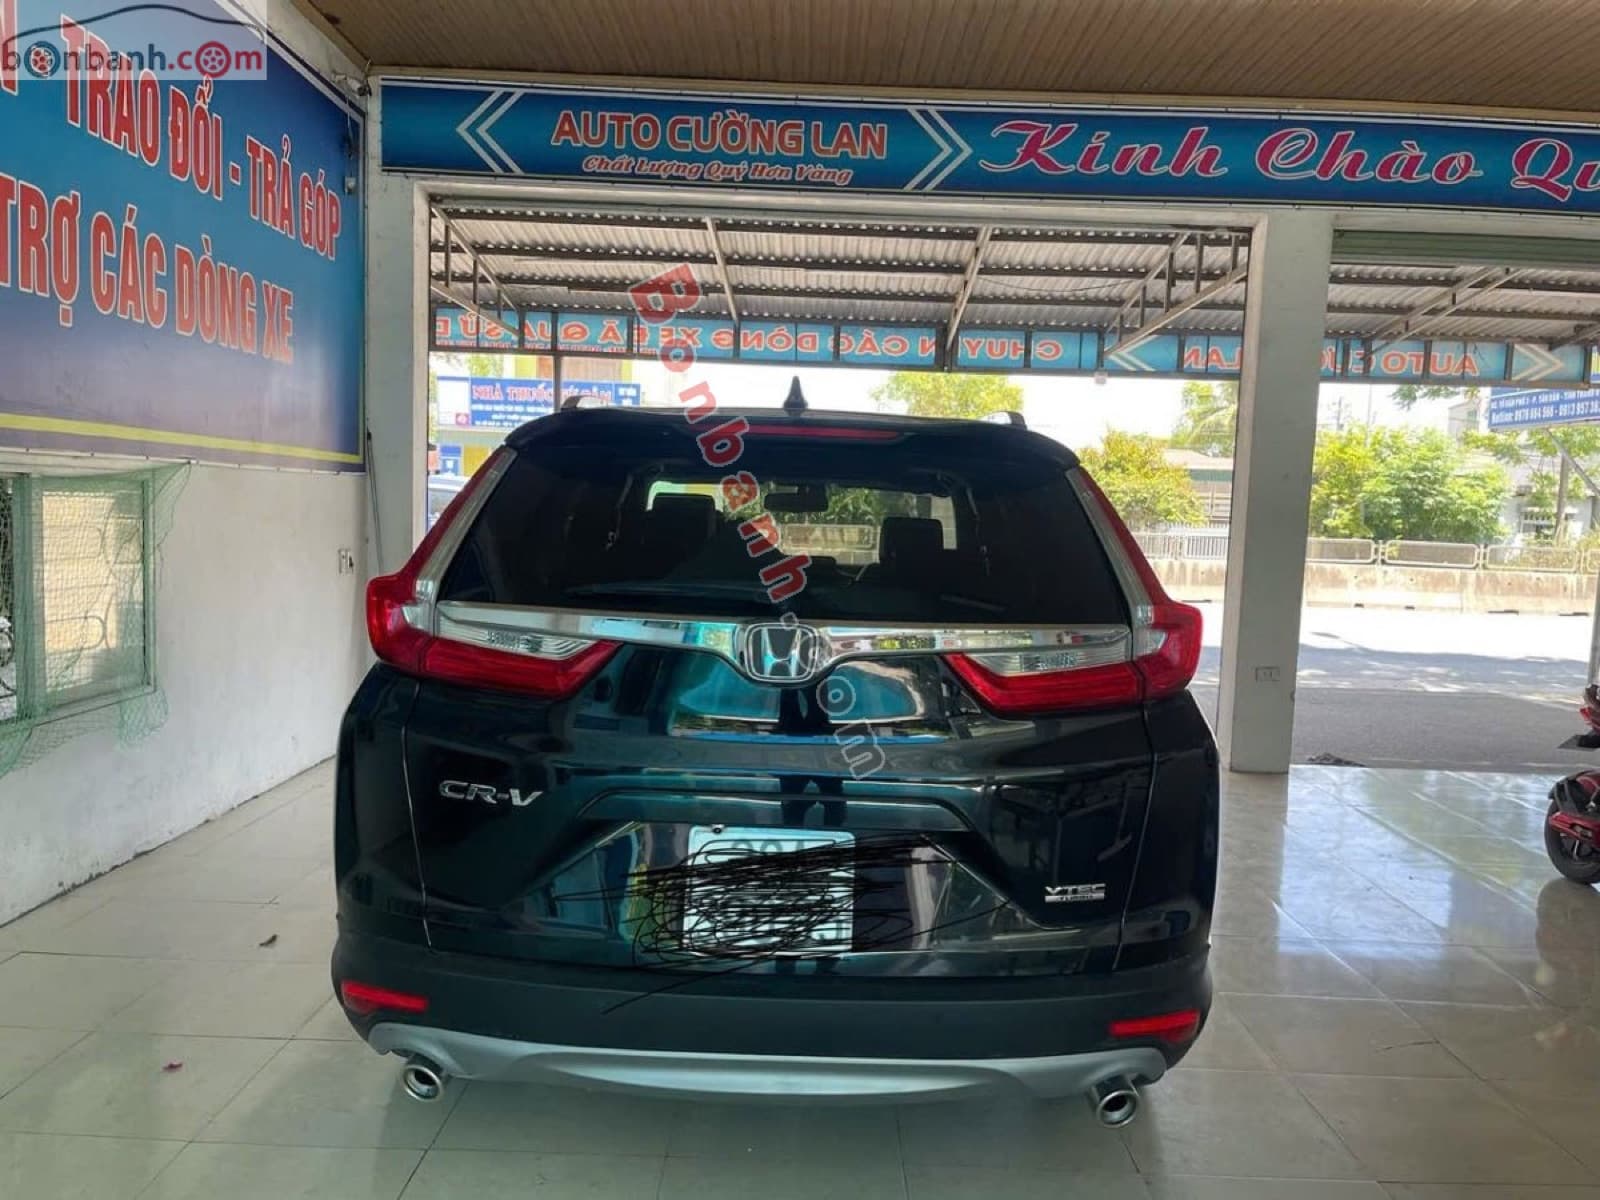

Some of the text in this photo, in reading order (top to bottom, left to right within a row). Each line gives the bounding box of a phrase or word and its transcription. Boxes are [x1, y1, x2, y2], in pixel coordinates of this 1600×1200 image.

[60, 13, 161, 167] TRAO
[168, 74, 223, 200] ĐỔI
[246, 133, 296, 240] TRẢ
[299, 168, 342, 261] GÓP
[551, 109, 887, 159] AUTO CƯỜNG LAN
[1255, 127, 1483, 185] Chào
[91, 203, 167, 329] CÁC
[174, 234, 257, 354] DÒNG
[262, 280, 294, 365] XE
[439, 780, 543, 806] CR-V
